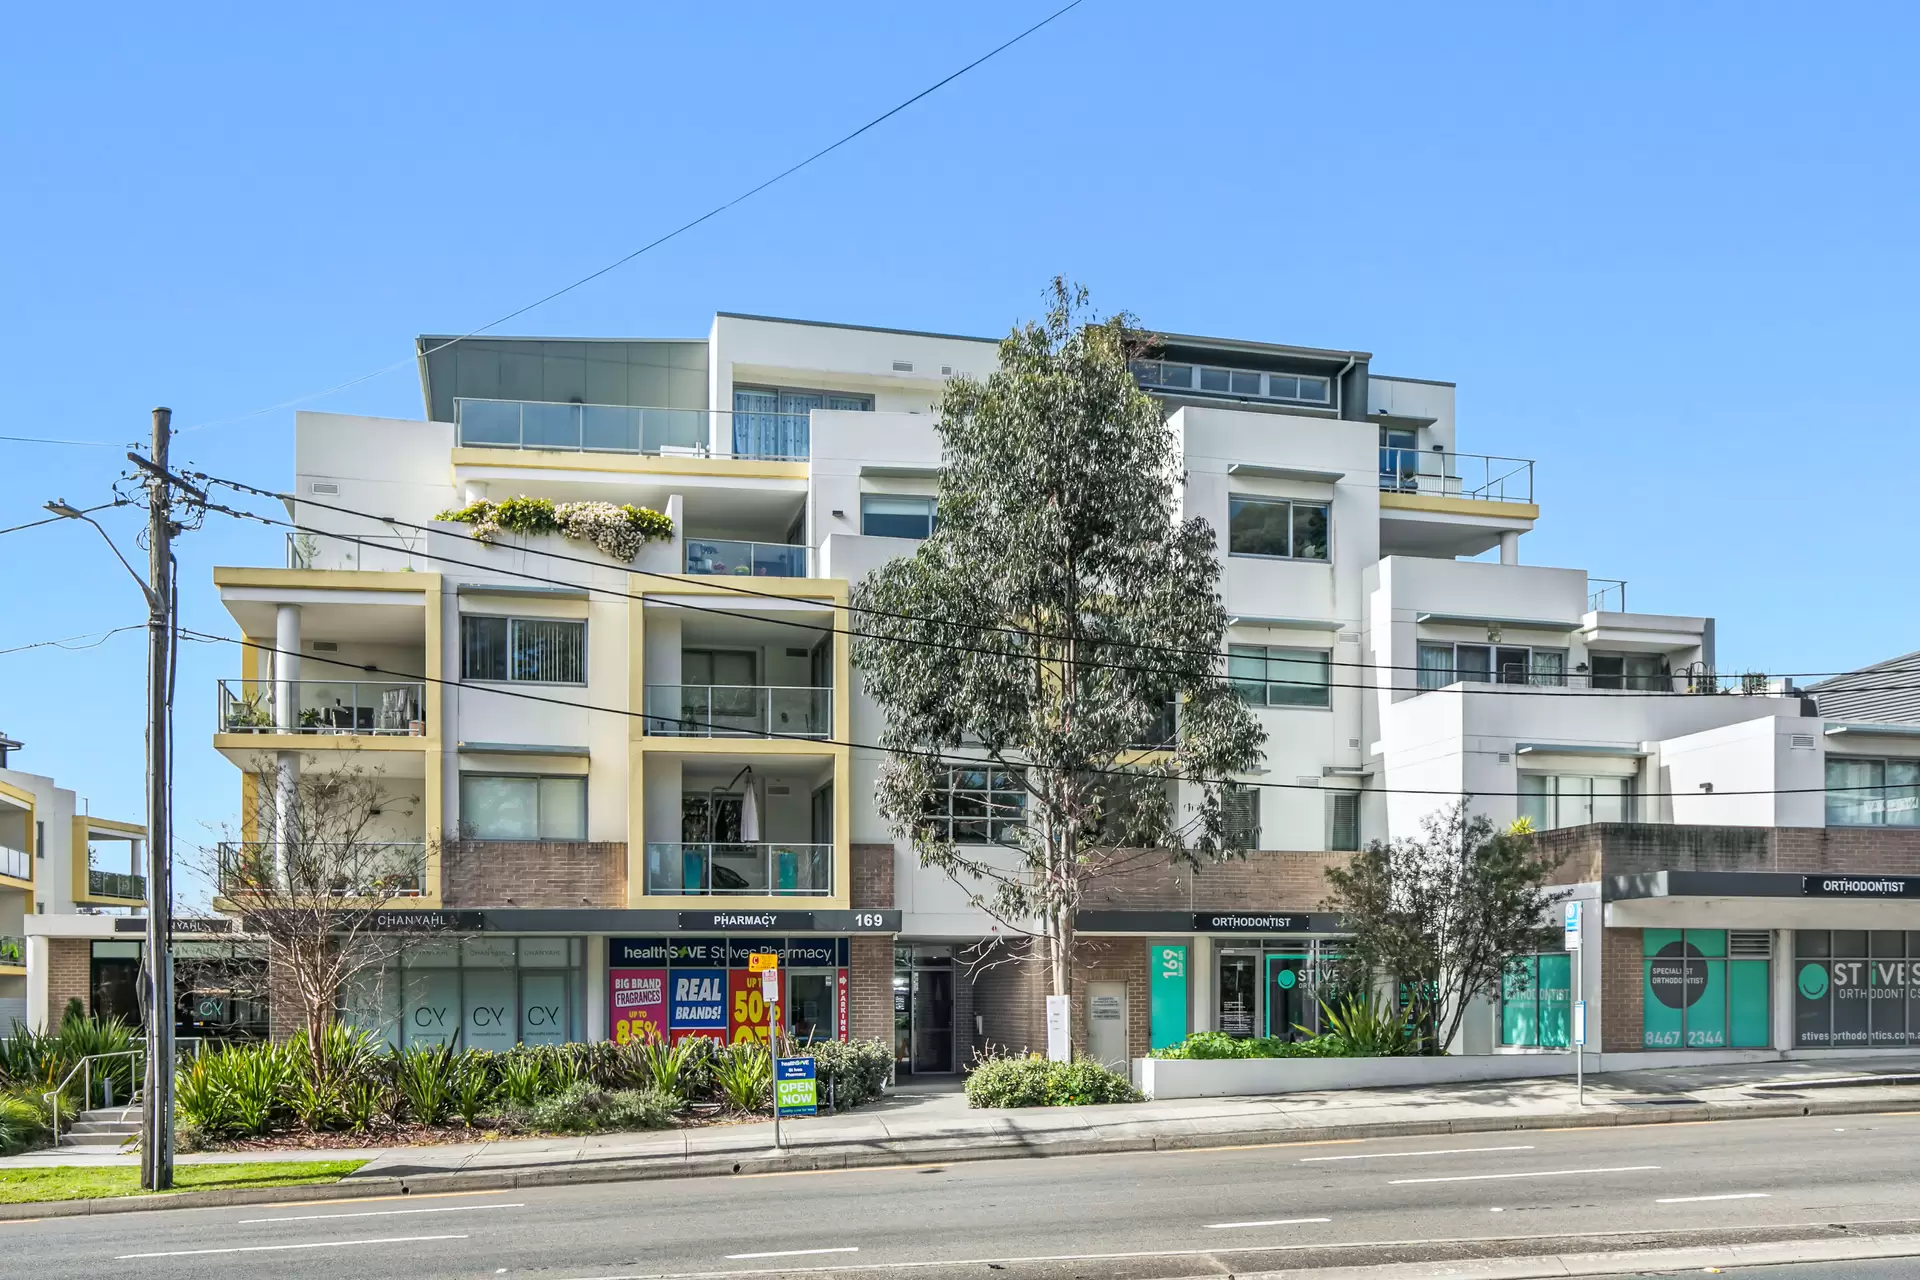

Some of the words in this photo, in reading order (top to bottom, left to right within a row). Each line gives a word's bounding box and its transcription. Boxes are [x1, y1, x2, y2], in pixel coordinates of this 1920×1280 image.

[1823, 880, 1905, 892] ORTHODONTIST
[377, 915, 447, 925] CHANYAHL
[714, 915, 777, 925] PHARMACY
[855, 914, 883, 927] 169
[1212, 917, 1291, 927] ORTHODONTIST
[711, 946, 725, 959] St
[760, 946, 832, 962] Pharmacy
[1163, 949, 1179, 979] 169
[1298, 969, 1315, 982] ST
[1652, 967, 1693, 975] SPECIALIST
[1834, 963, 1862, 985] ST
[615, 978, 630, 989] BIG
[631, 978, 662, 989] BRAND
[747, 977, 757, 988] UP
[1652, 977, 1704, 985] ORTHODONTIST
[675, 978, 721, 1001] REAL
[1839, 988, 1920, 999] ORTHODONTC
[616, 989, 661, 1006] FRAGRANCES
[415, 1007, 447, 1027] CY
[473, 1006, 504, 1027] CY
[528, 1006, 559, 1026] CY
[675, 1005, 722, 1020] BRANDS!
[1645, 1031, 1680, 1045] 8467
[1687, 1031, 1723, 1045] 2344
[780, 1082, 814, 1093] OPEN
[782, 1094, 812, 1104] NOW
